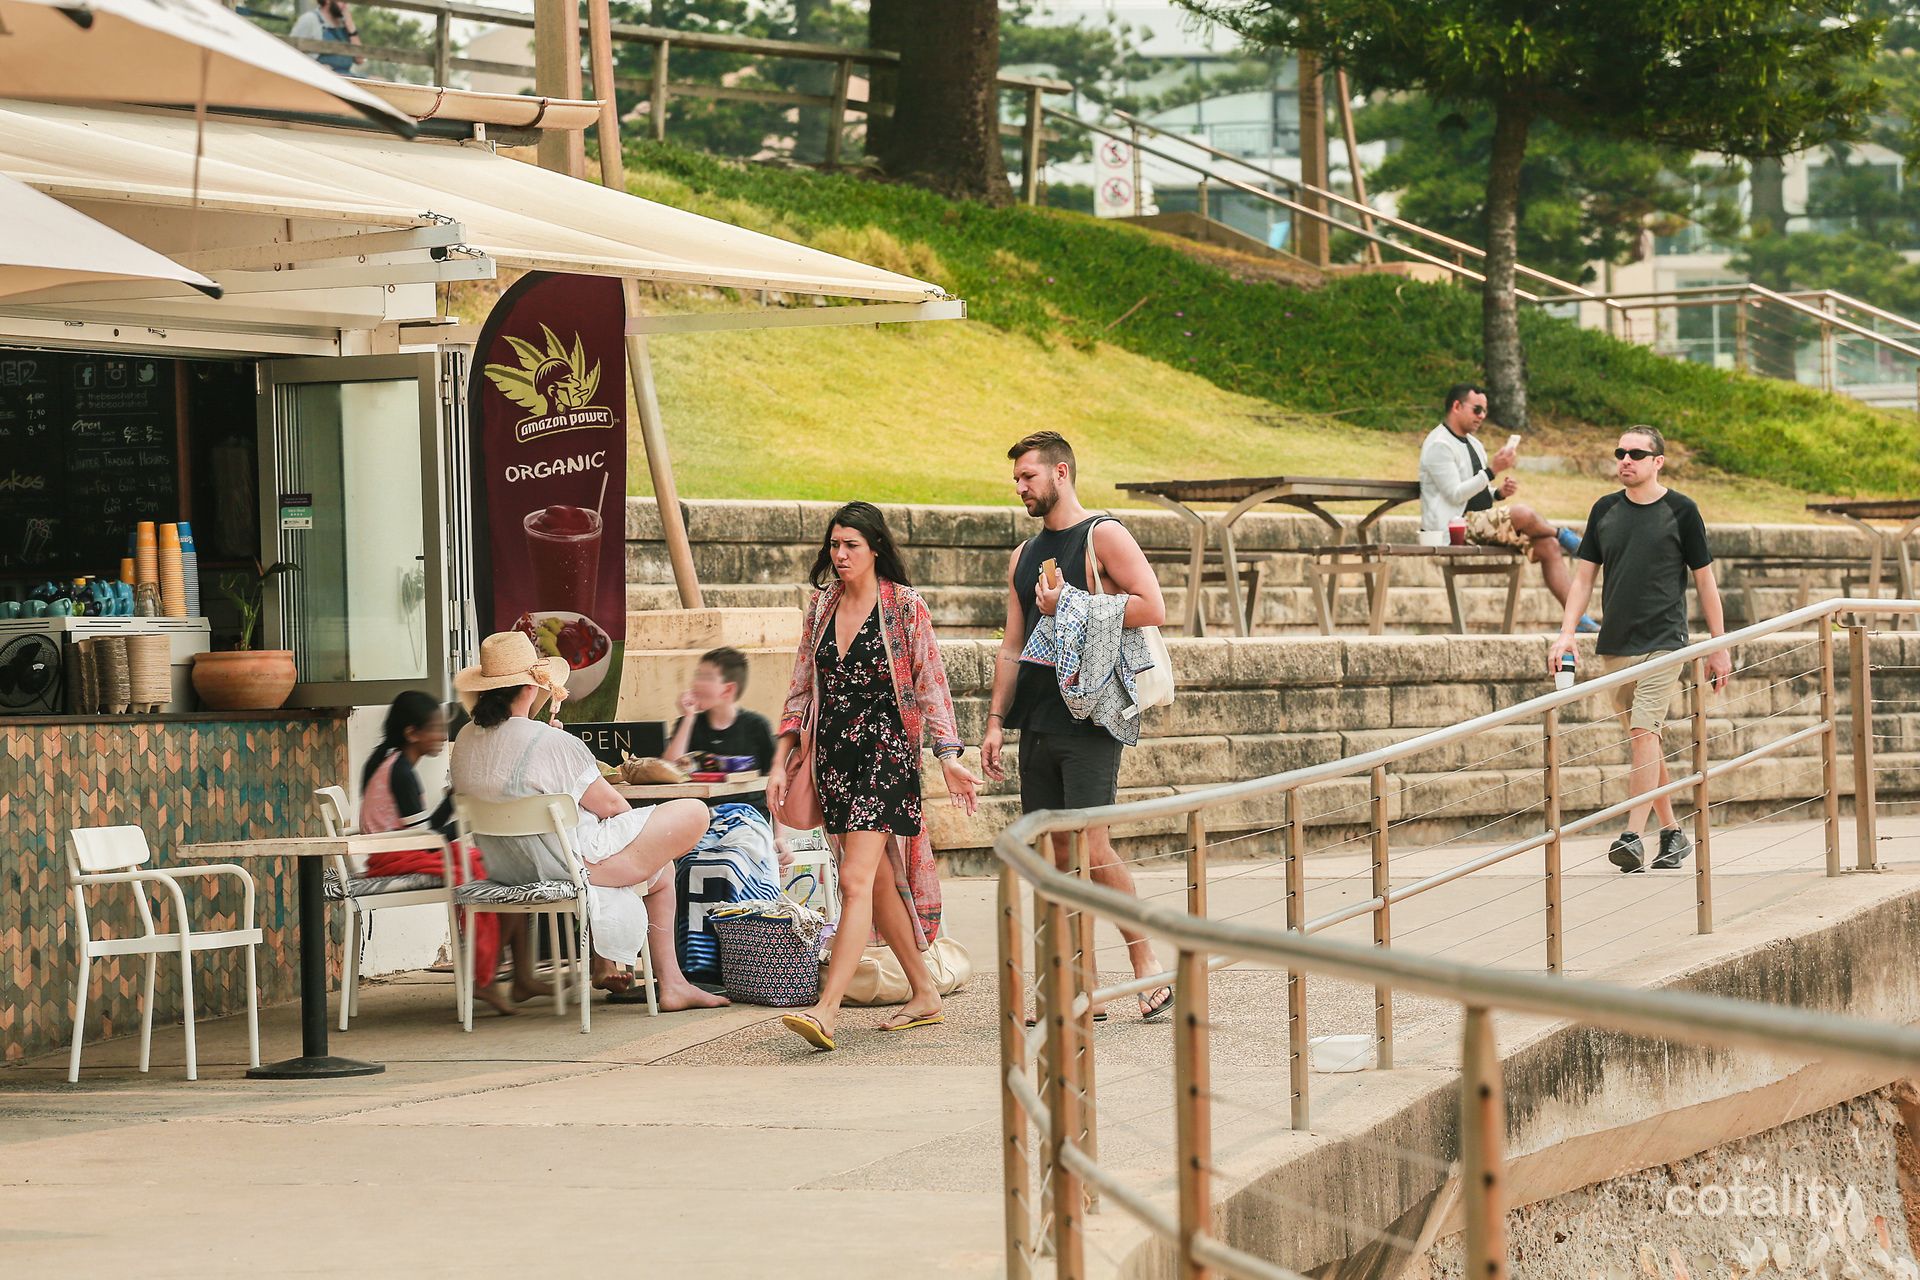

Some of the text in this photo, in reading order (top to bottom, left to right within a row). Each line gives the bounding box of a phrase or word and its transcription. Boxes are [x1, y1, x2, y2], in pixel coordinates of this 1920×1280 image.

[505, 451, 606, 482] ORGANIC
[0, 468, 45, 491] akes
[582, 730, 631, 750] PEN
